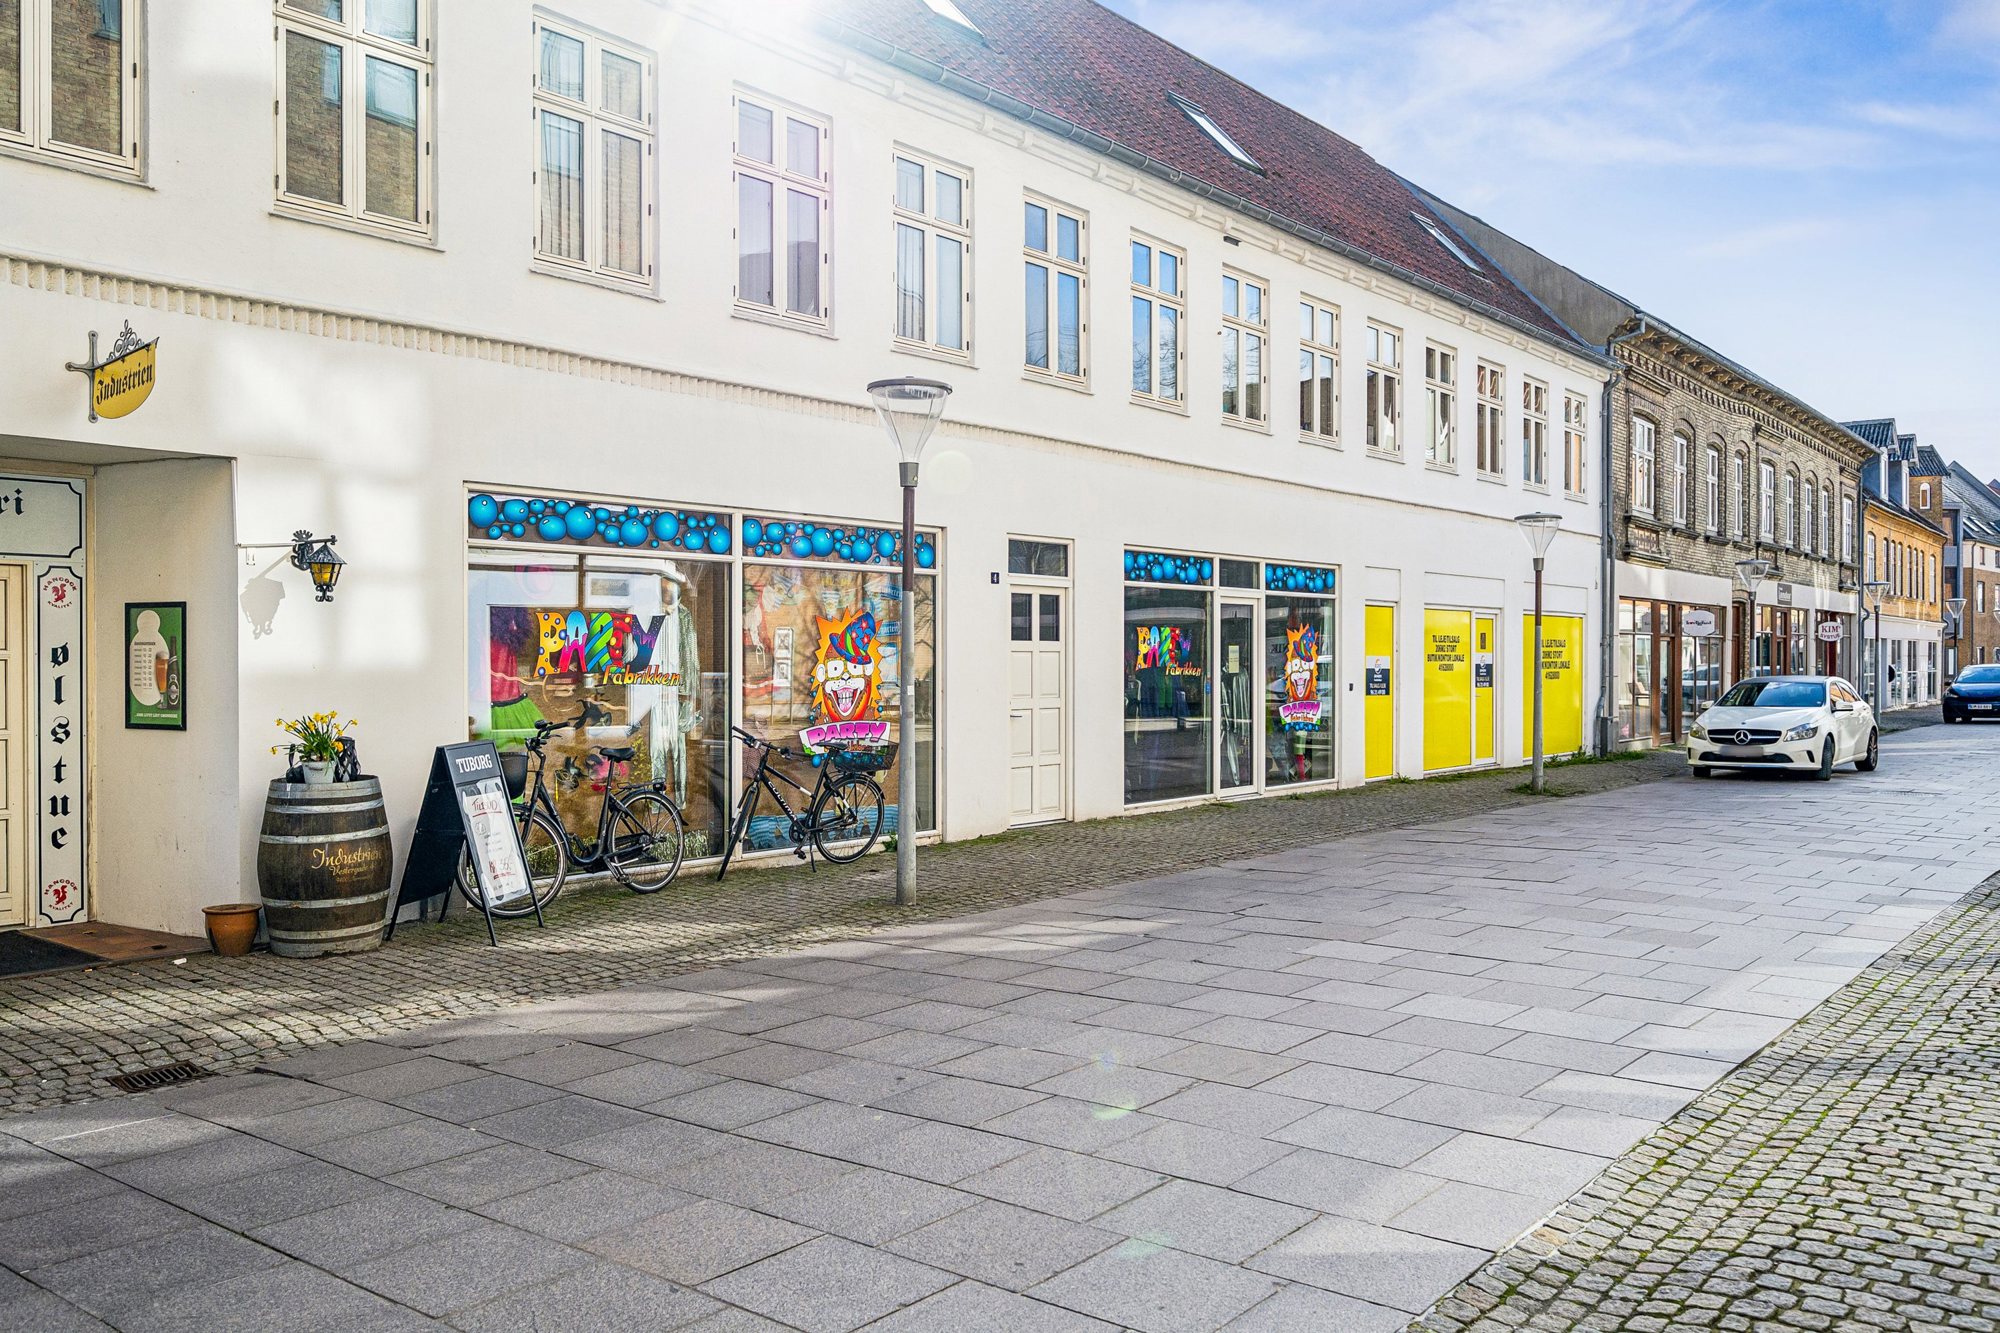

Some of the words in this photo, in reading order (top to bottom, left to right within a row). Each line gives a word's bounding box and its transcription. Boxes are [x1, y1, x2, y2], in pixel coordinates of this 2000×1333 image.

[96, 362, 153, 405] Industrien
[43, 576, 77, 591] HANCOCK
[533, 609, 666, 678] PARTY
[1135, 625, 1193, 671] PARTY
[1281, 701, 1321, 718] PARTY
[806, 722, 887, 746] PARTY
[455, 753, 493, 774] TUBORG
[311, 845, 382, 870] Industrien
[43, 878, 78, 896] HANCOCK
